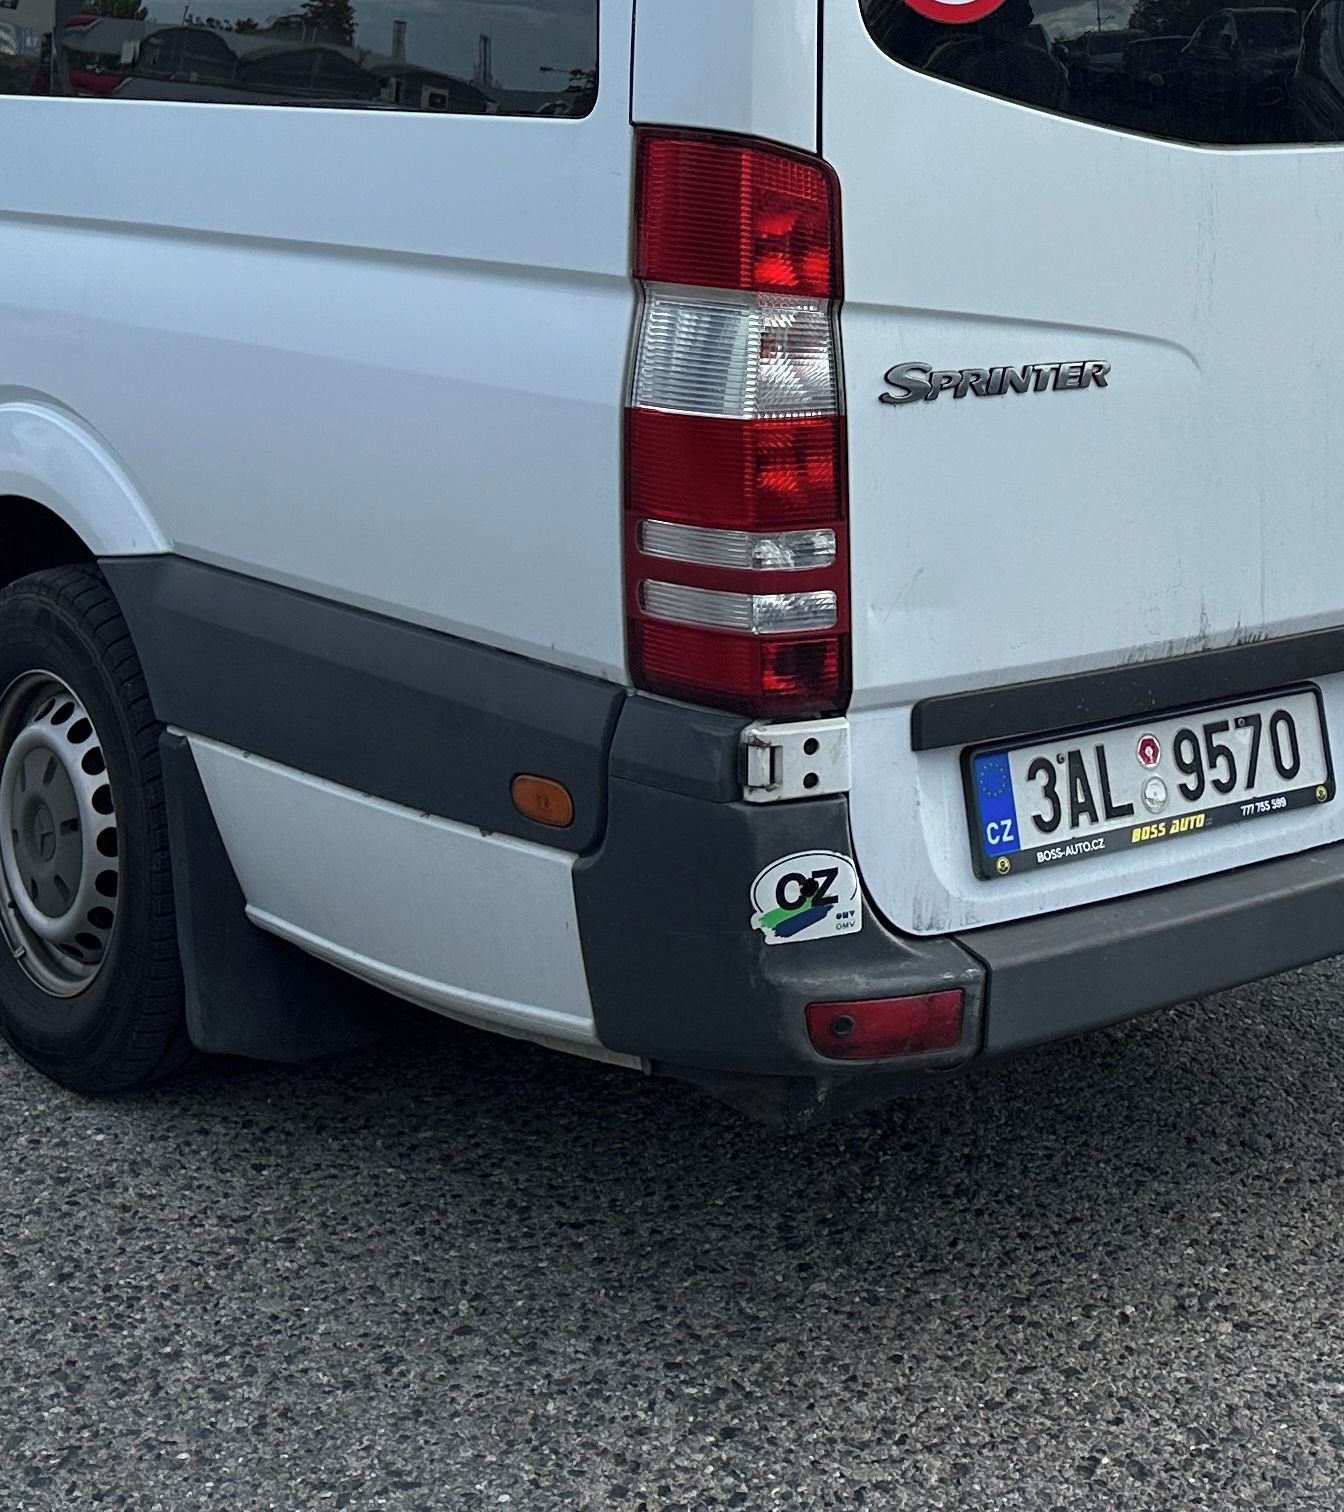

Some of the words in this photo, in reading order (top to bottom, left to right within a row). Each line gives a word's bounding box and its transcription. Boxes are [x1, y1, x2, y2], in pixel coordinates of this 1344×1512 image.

[878, 359, 1112, 404] SPRINTER
[985, 818, 1015, 845] CZ
[1025, 745, 1135, 833] 3AL
[1172, 709, 1302, 802] 9570
[1131, 821, 1166, 843] BOSS
[1169, 813, 1206, 835] AUTO
[1036, 838, 1106, 863] BOSS-AUTO.CZ
